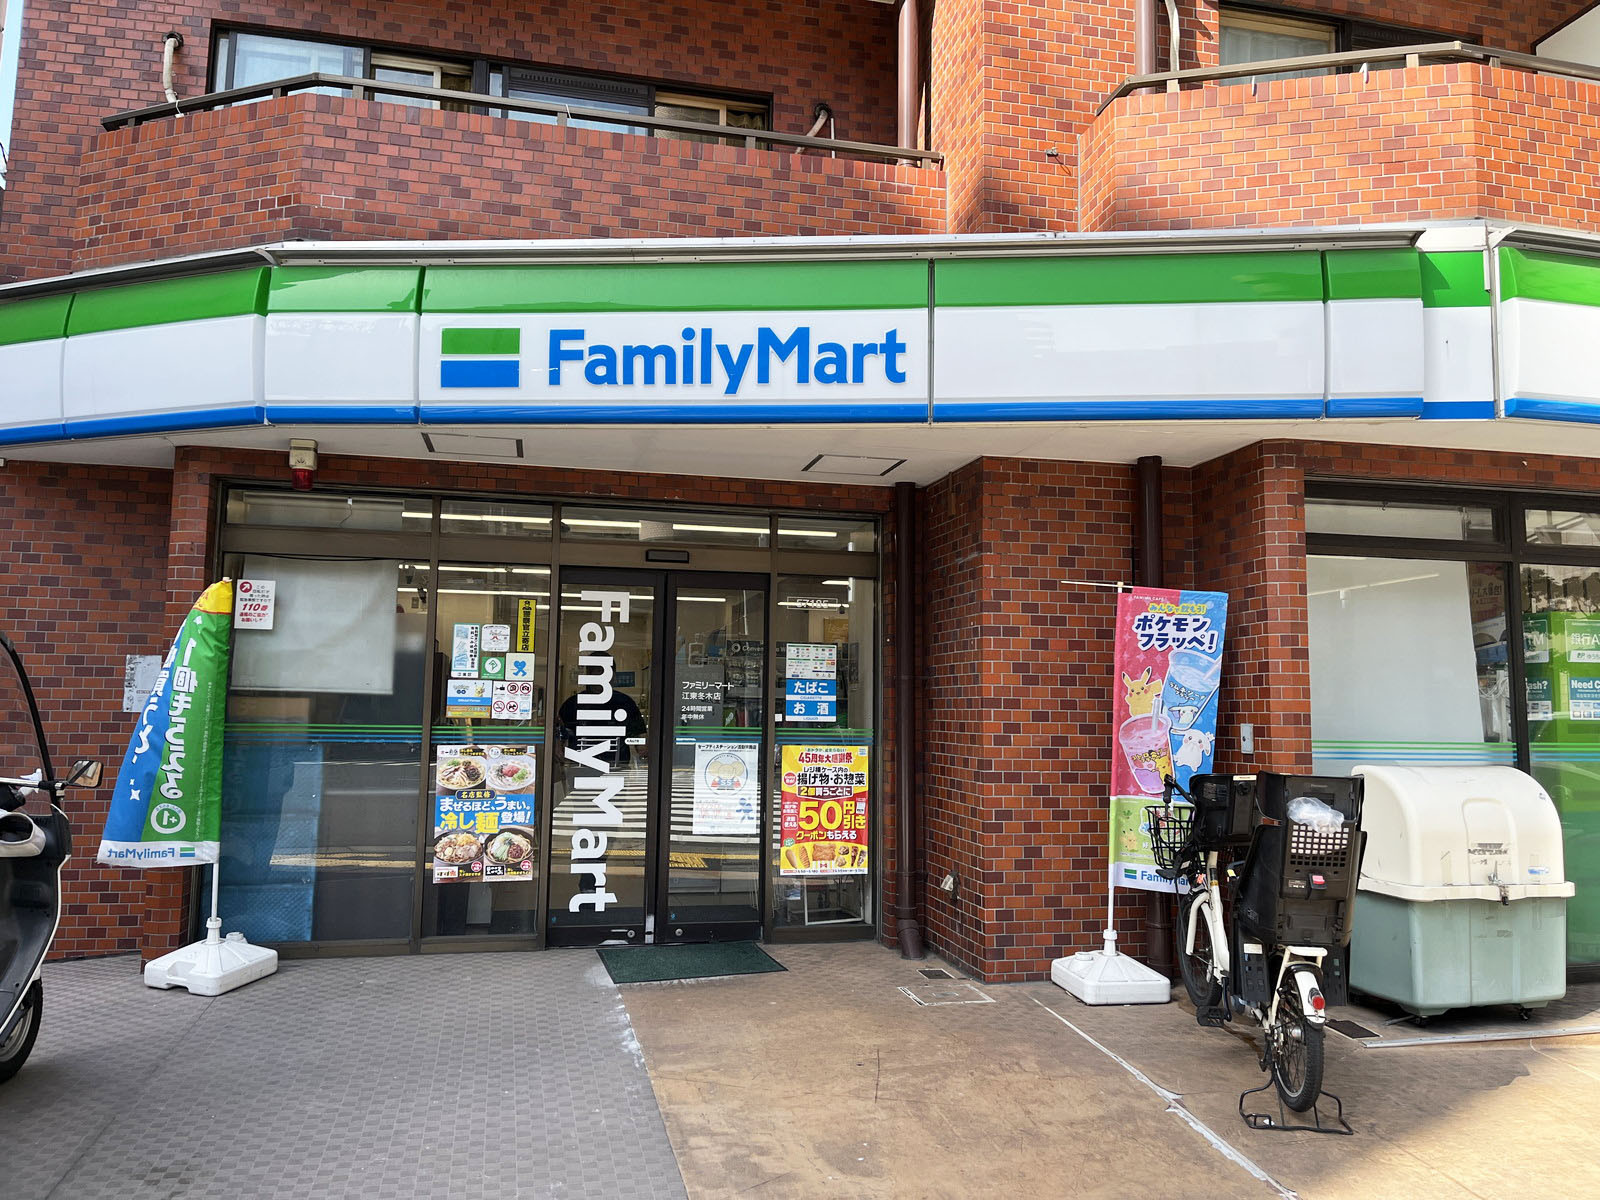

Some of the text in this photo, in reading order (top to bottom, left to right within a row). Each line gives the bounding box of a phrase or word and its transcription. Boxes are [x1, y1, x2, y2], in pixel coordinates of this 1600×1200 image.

[549, 327, 906, 394] FamilyMart
[242, 603, 268, 611] 110番
[1135, 614, 1208, 632] ポケモン
[1140, 633, 1215, 650] フラッペ!
[682, 681, 734, 690] ファミリーマート
[793, 681, 829, 693] たばこ
[1528, 681, 1548, 689] ash?
[1571, 680, 1593, 688] Need
[682, 692, 721, 700] 江東冬木店
[565, 590, 630, 912] FamilyMart
[798, 752, 852, 763] 45周年大感謝祭
[797, 773, 865, 785] 揚げ物・お惣菜
[800, 787, 851, 796] 2個買うごとに
[440, 797, 531, 811] まぜるほど、うまい。
[501, 811, 531, 824] 登場!
[798, 801, 843, 830] 50
[440, 812, 500, 834] 冷し麺
[796, 831, 857, 840] クーポンもらえる
